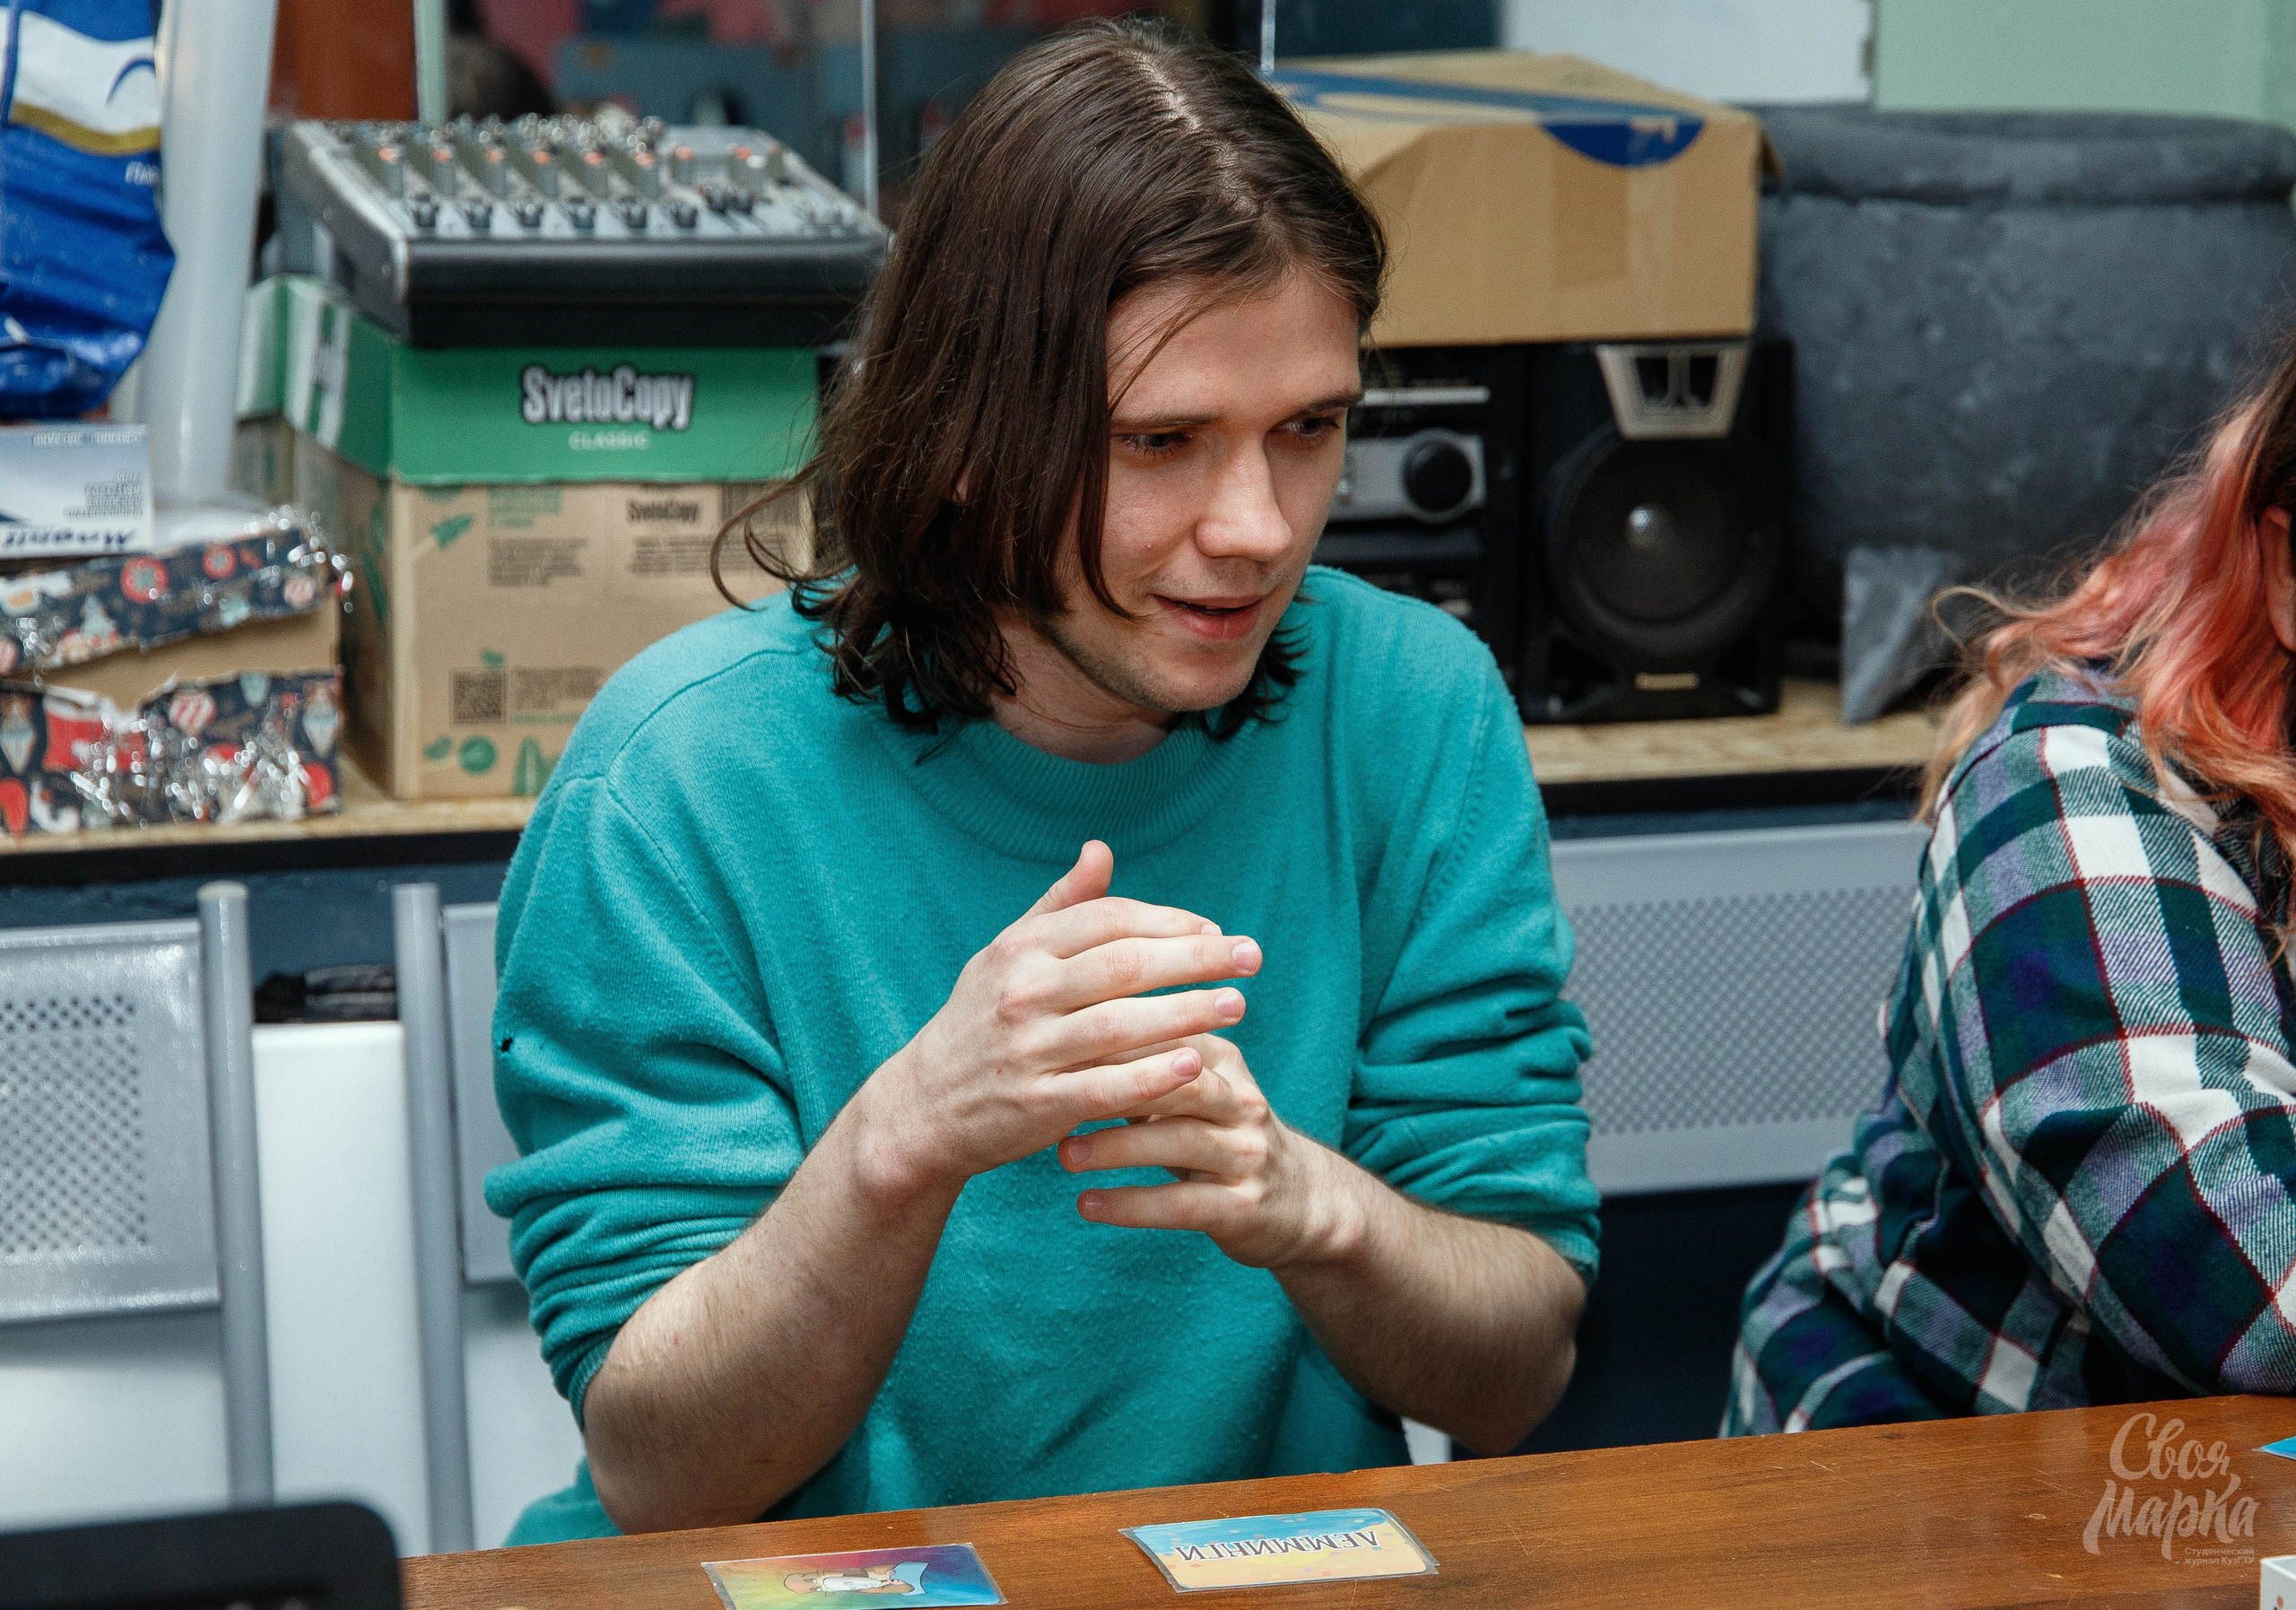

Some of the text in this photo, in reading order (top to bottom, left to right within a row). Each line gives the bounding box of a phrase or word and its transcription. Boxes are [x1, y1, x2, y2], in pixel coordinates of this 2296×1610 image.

[522, 364, 694, 431] SvetoCopy
[569, 431, 650, 450] CLASSIC
[1172, 1530, 1380, 1562] ЛЕММИНГИ
